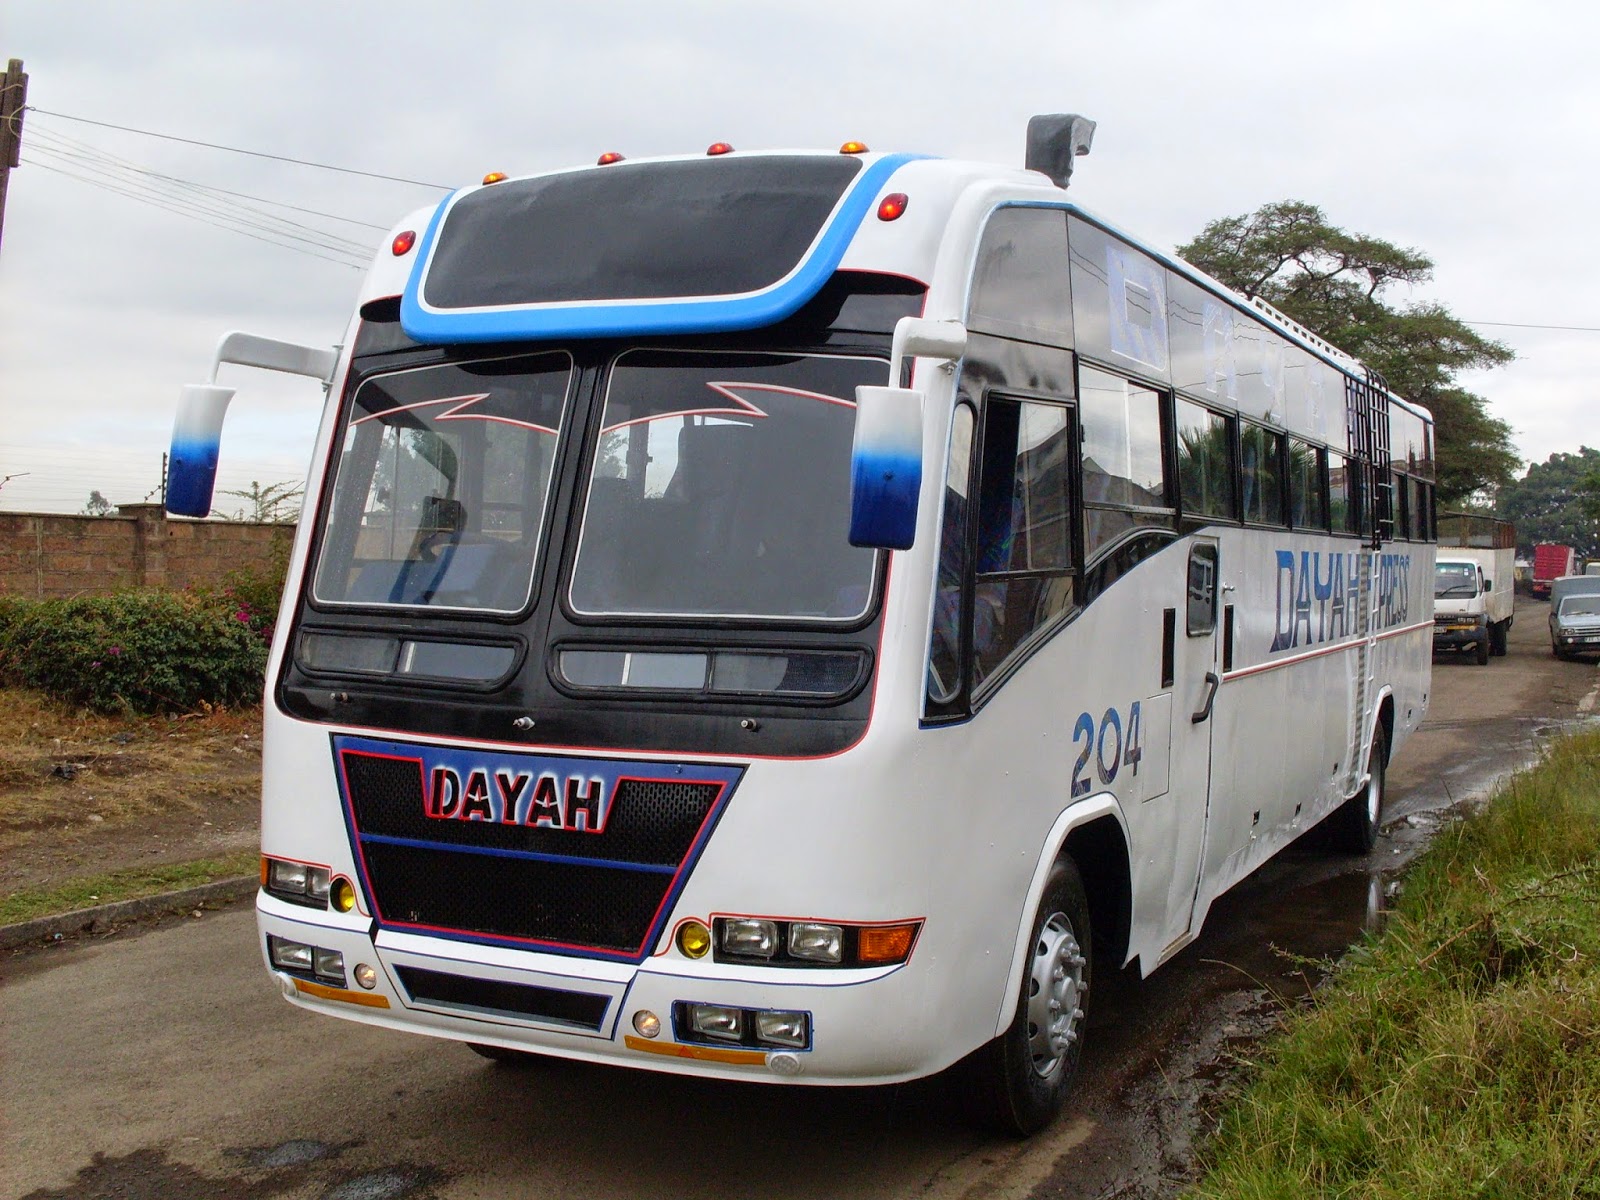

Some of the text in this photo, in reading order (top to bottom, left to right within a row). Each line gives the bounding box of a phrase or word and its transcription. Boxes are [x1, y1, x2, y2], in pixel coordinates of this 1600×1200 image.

[1269, 550, 1360, 653] DAYAH
[429, 766, 604, 832] DAYAH
[1071, 701, 1141, 799] 204
